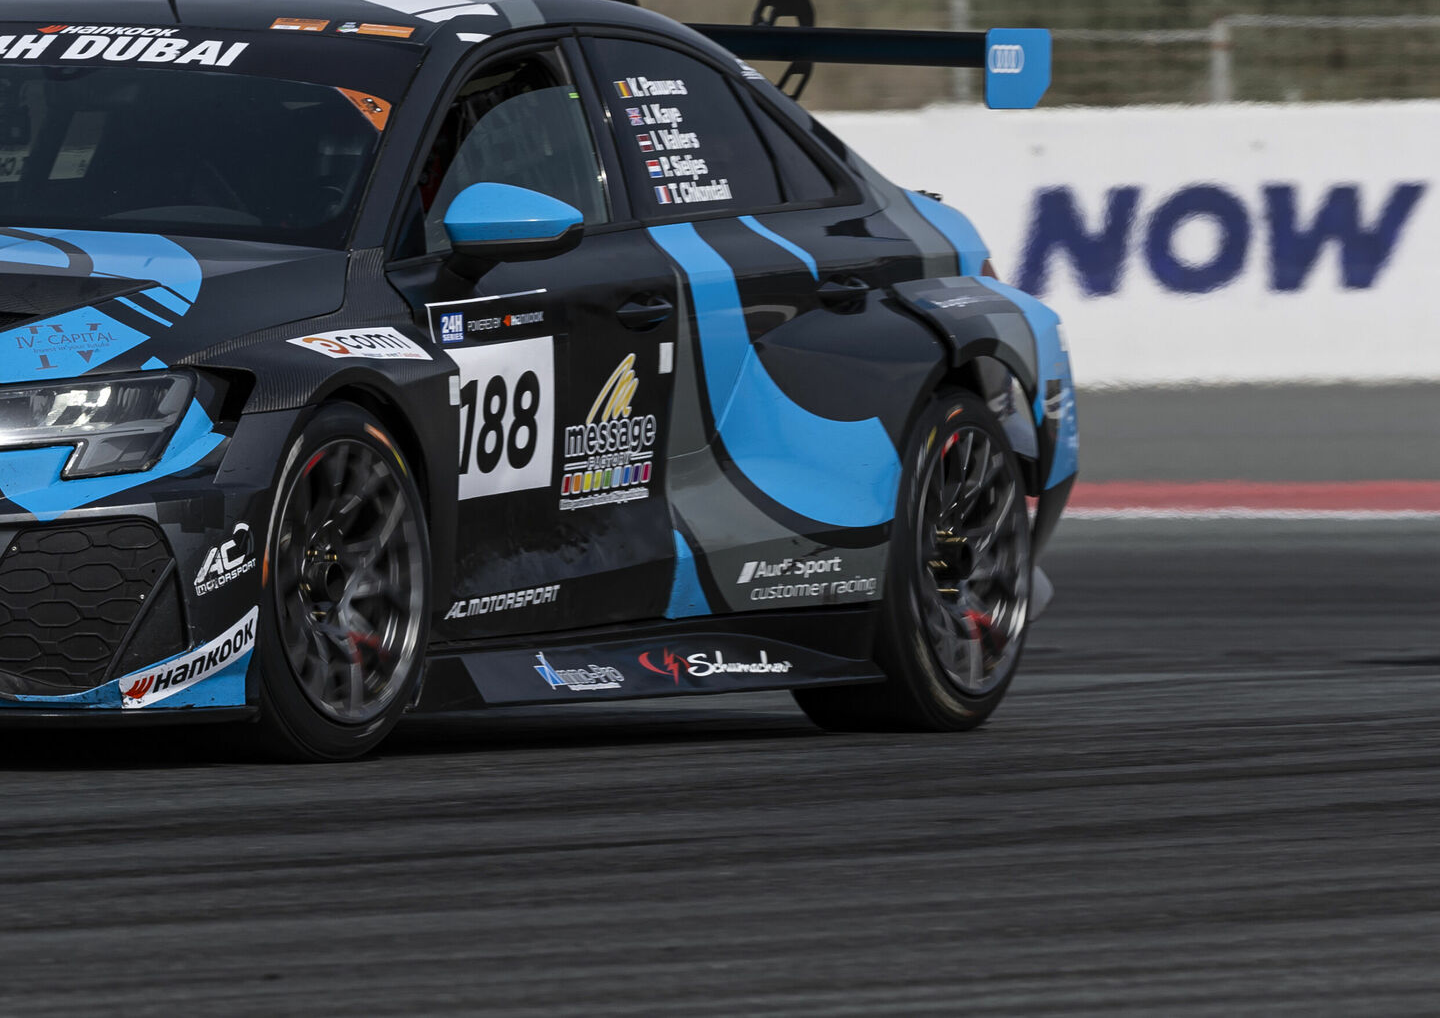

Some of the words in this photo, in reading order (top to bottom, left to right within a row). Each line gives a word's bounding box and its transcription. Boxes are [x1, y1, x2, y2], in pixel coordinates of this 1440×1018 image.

[60, 35, 251, 67] DUBAI
[1013, 181, 1428, 299] NOW
[441, 314, 463, 333] 24H
[442, 333, 464, 343] SERIES
[47, 332, 118, 345] CAPITAL
[459, 370, 541, 475] 188
[565, 414, 657, 458] message
[587, 451, 632, 471] FACTORY
[195, 557, 257, 597] MOTORSPORT
[750, 582, 829, 601] customer
[830, 575, 877, 595] racing
